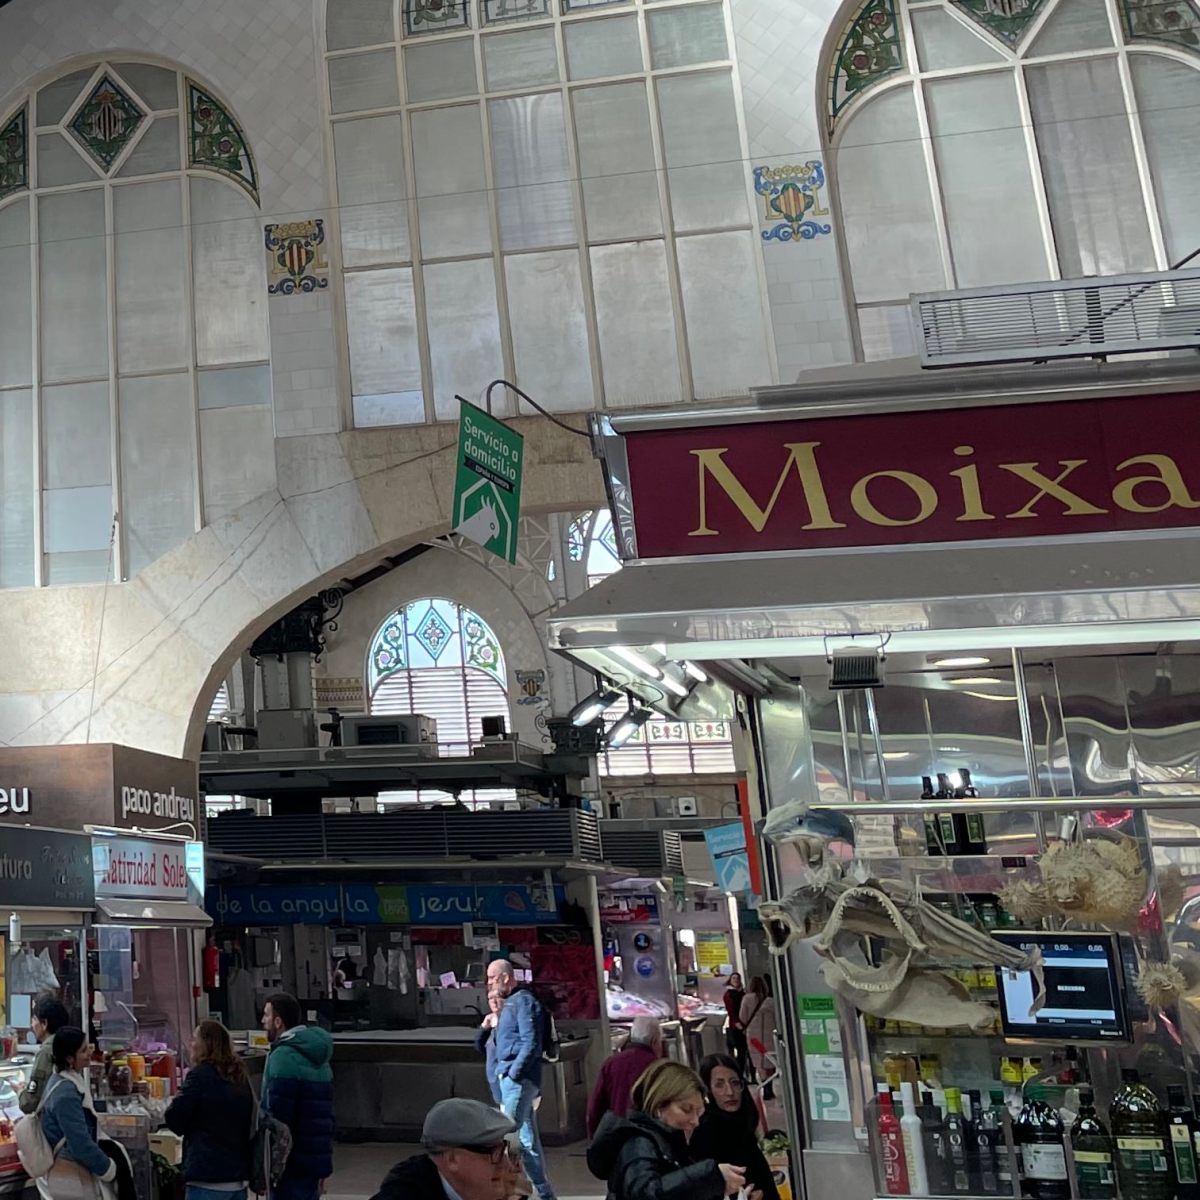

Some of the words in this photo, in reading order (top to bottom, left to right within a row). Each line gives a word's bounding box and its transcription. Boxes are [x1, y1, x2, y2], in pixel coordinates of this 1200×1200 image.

[463, 416, 509, 456] Servicio
[511, 450, 519, 462] a
[464, 437, 516, 480] domicilio
[687, 441, 1200, 537] Moixa
[122, 786, 152, 819] paco
[153, 786, 195, 821] andreu
[216, 894, 242, 914] de
[250, 893, 274, 914] la
